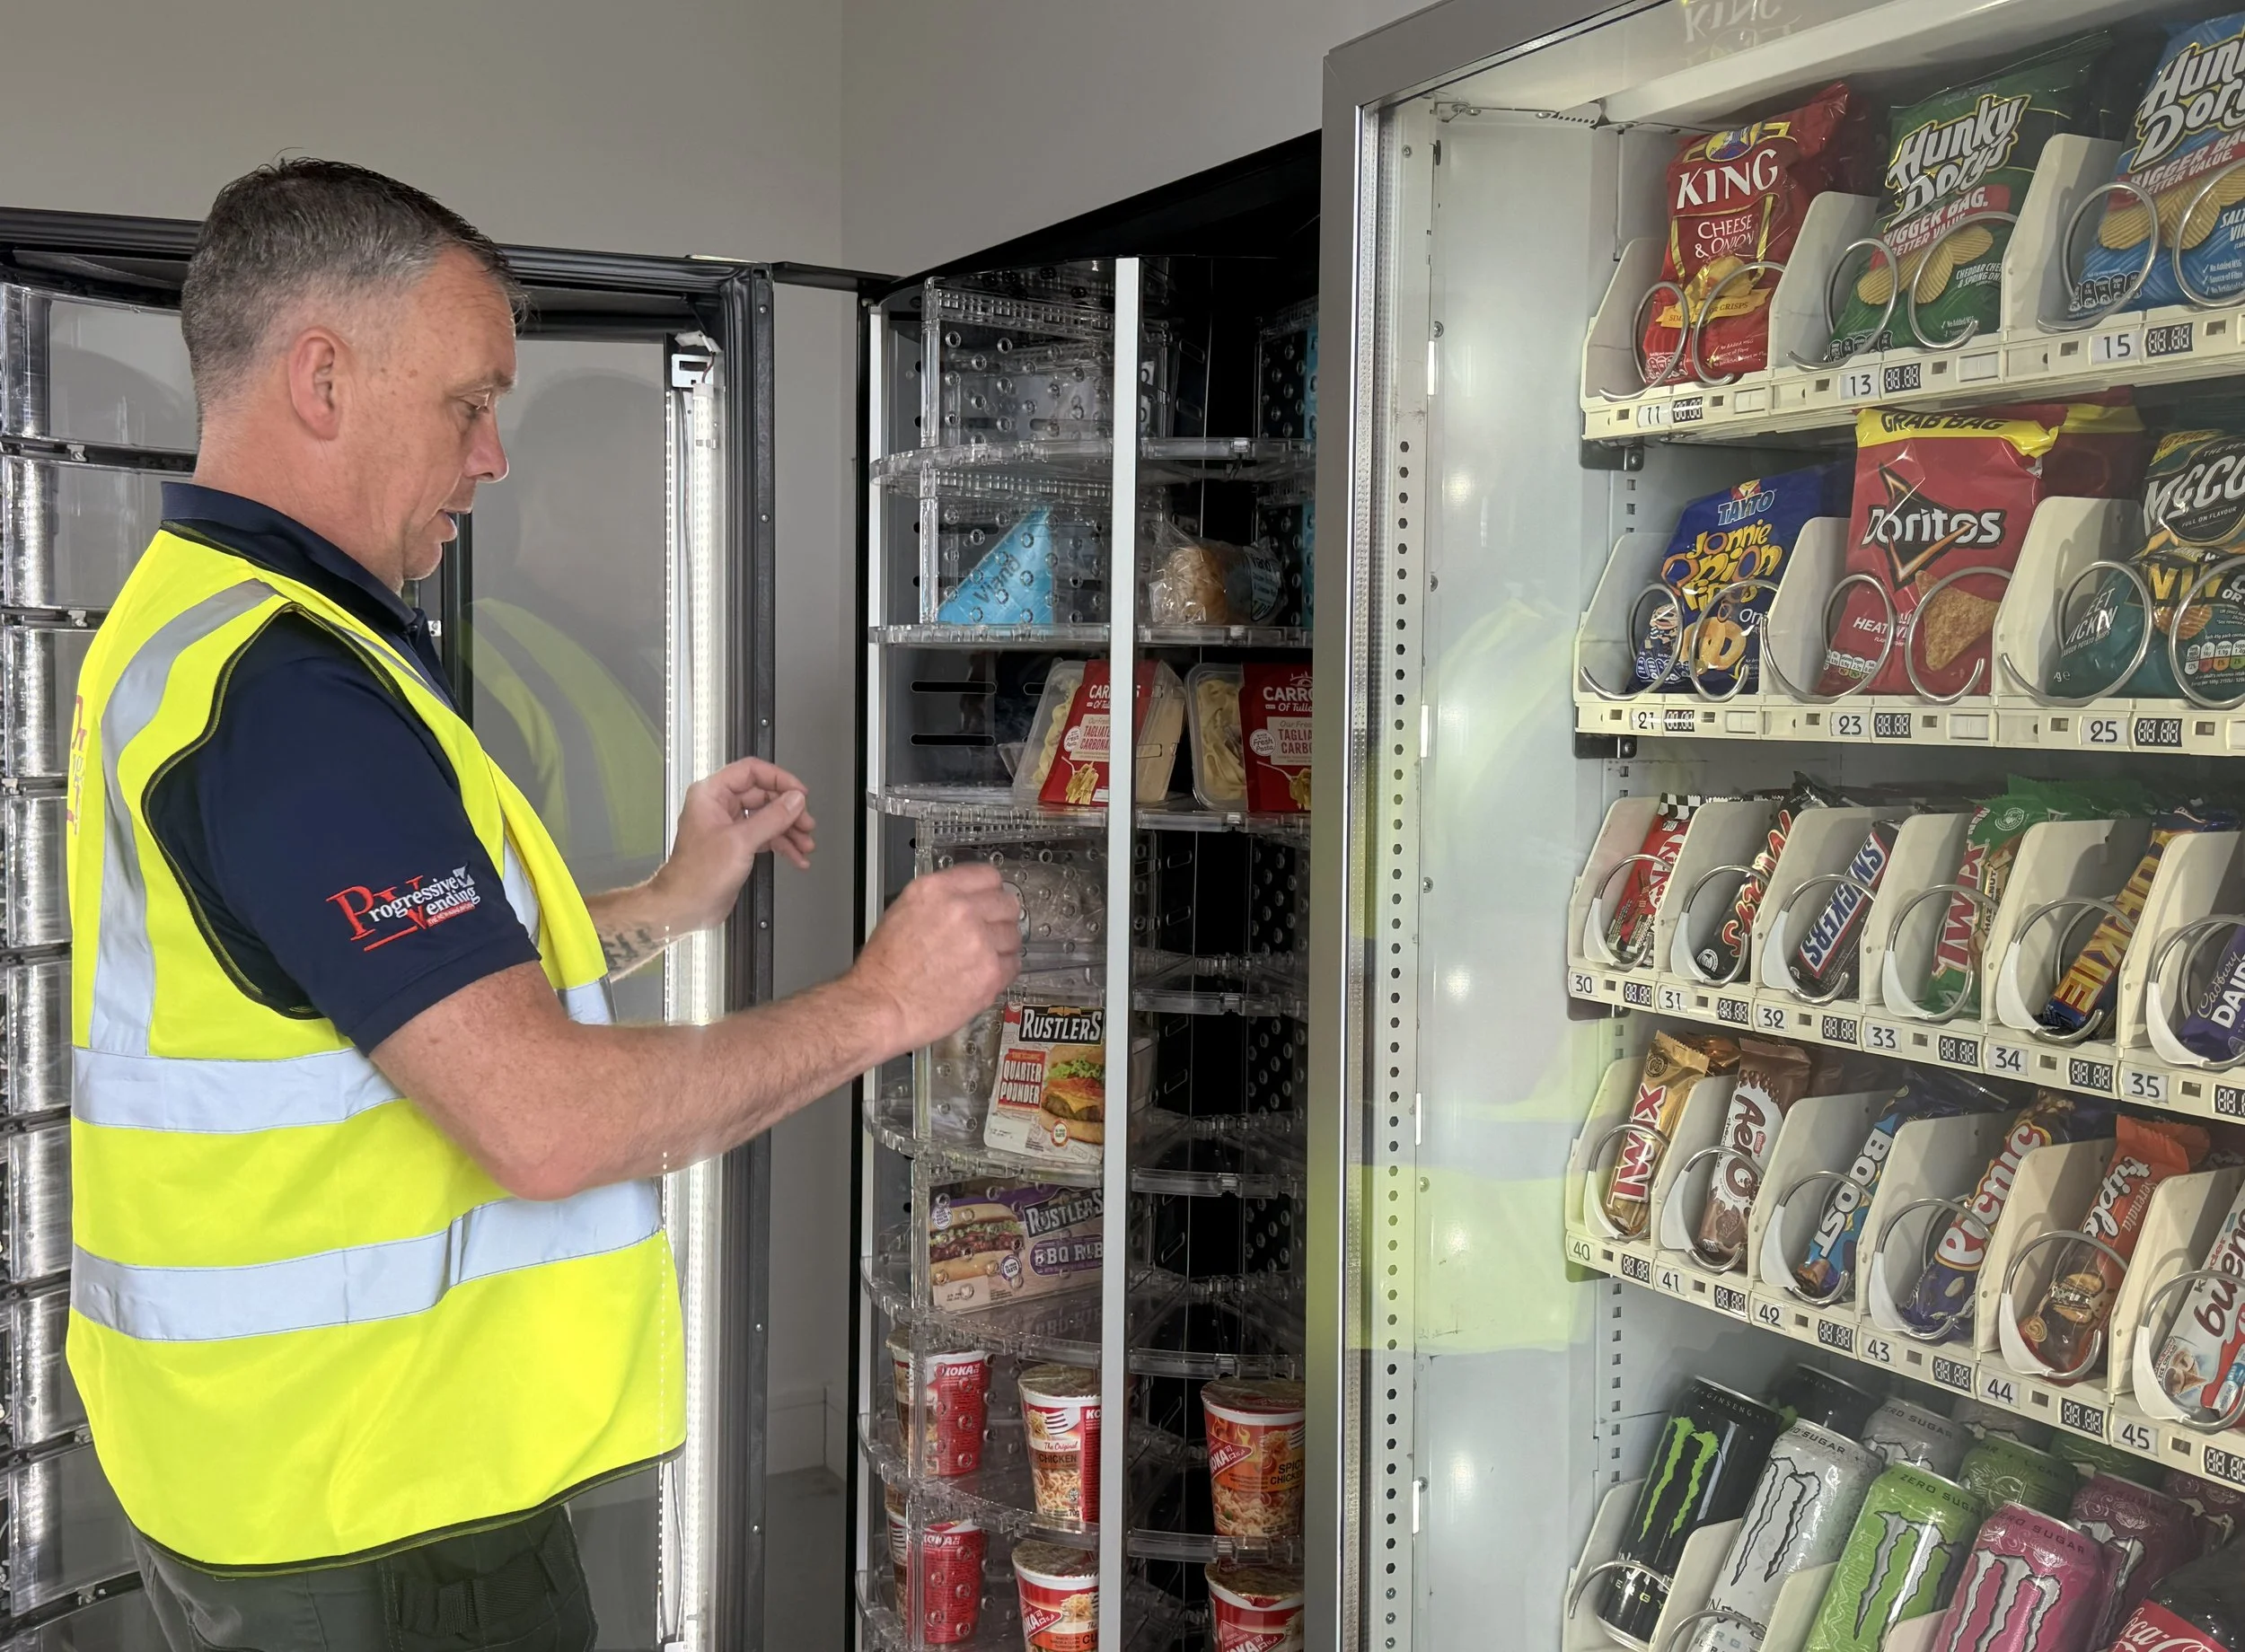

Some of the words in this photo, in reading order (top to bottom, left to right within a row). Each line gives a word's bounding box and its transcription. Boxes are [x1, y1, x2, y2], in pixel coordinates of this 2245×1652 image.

[1888, 98, 2025, 190] Hunky
[2131, 145, 2209, 187] BIGGER
[1677, 149, 1778, 210] KING
[2144, 169, 2188, 196] ETTER
[1947, 186, 1989, 218] BAG.
[1697, 214, 1753, 240] CHEESE
[1695, 243, 1709, 259] &
[1710, 230, 1755, 255] ONION
[1719, 302, 1748, 311] CRISPS
[2104, 333, 2131, 359] 15
[1850, 374, 1871, 397] 13
[1647, 405, 1660, 426] 11
[1881, 412, 1944, 434] GRAB
[1943, 415, 2009, 431] BAG
[1718, 488, 1776, 526] TAYTO
[2209, 505, 2238, 520] FLAVOUR
[1862, 507, 2003, 546] Doritos
[1638, 711, 1655, 730] 21
[1838, 716, 1862, 735] 23
[2090, 720, 2118, 743] 25
[1968, 807, 1991, 835] NEW
[325, 876, 460, 941] Progressive
[1575, 975, 1592, 994] 30
[2197, 952, 2242, 1018] Cadbury
[1665, 990, 1681, 1011] 31
[1022, 1008, 1103, 1041] RUSTLERS
[1763, 1007, 1785, 1030] 32
[1871, 1028, 1897, 1050] 33
[1003, 1060, 1042, 1083] QUARTER
[1994, 1047, 2021, 1072] 34
[999, 1081, 1041, 1104] POUNDER
[2131, 1072, 2161, 1098] 35
[1814, 1128, 1894, 1258] BOOST
[1026, 1190, 1104, 1235] RUSTLERS
[2122, 1180, 2157, 1232] Serenata
[1573, 1241, 1590, 1260] 40
[1662, 1273, 1679, 1293] 41
[1759, 1304, 1780, 1327] 42
[1868, 1339, 1890, 1363] 43
[1987, 1377, 2013, 1403] 44
[1086, 1410, 1101, 1419] KO
[1706, 1393, 1752, 1417] GINSENG
[1908, 1415, 1953, 1440] SUGAR
[2121, 1424, 2150, 1451] 45
[1044, 1442, 1053, 1450] The
[1801, 1430, 1846, 1455] SUGAR
[1039, 1454, 1077, 1463] CHICKEN
[1279, 1460, 1303, 1474] SPIC
[1899, 1472, 1937, 1495] ZERO
[2031, 1525, 2085, 1555] SUGAR
